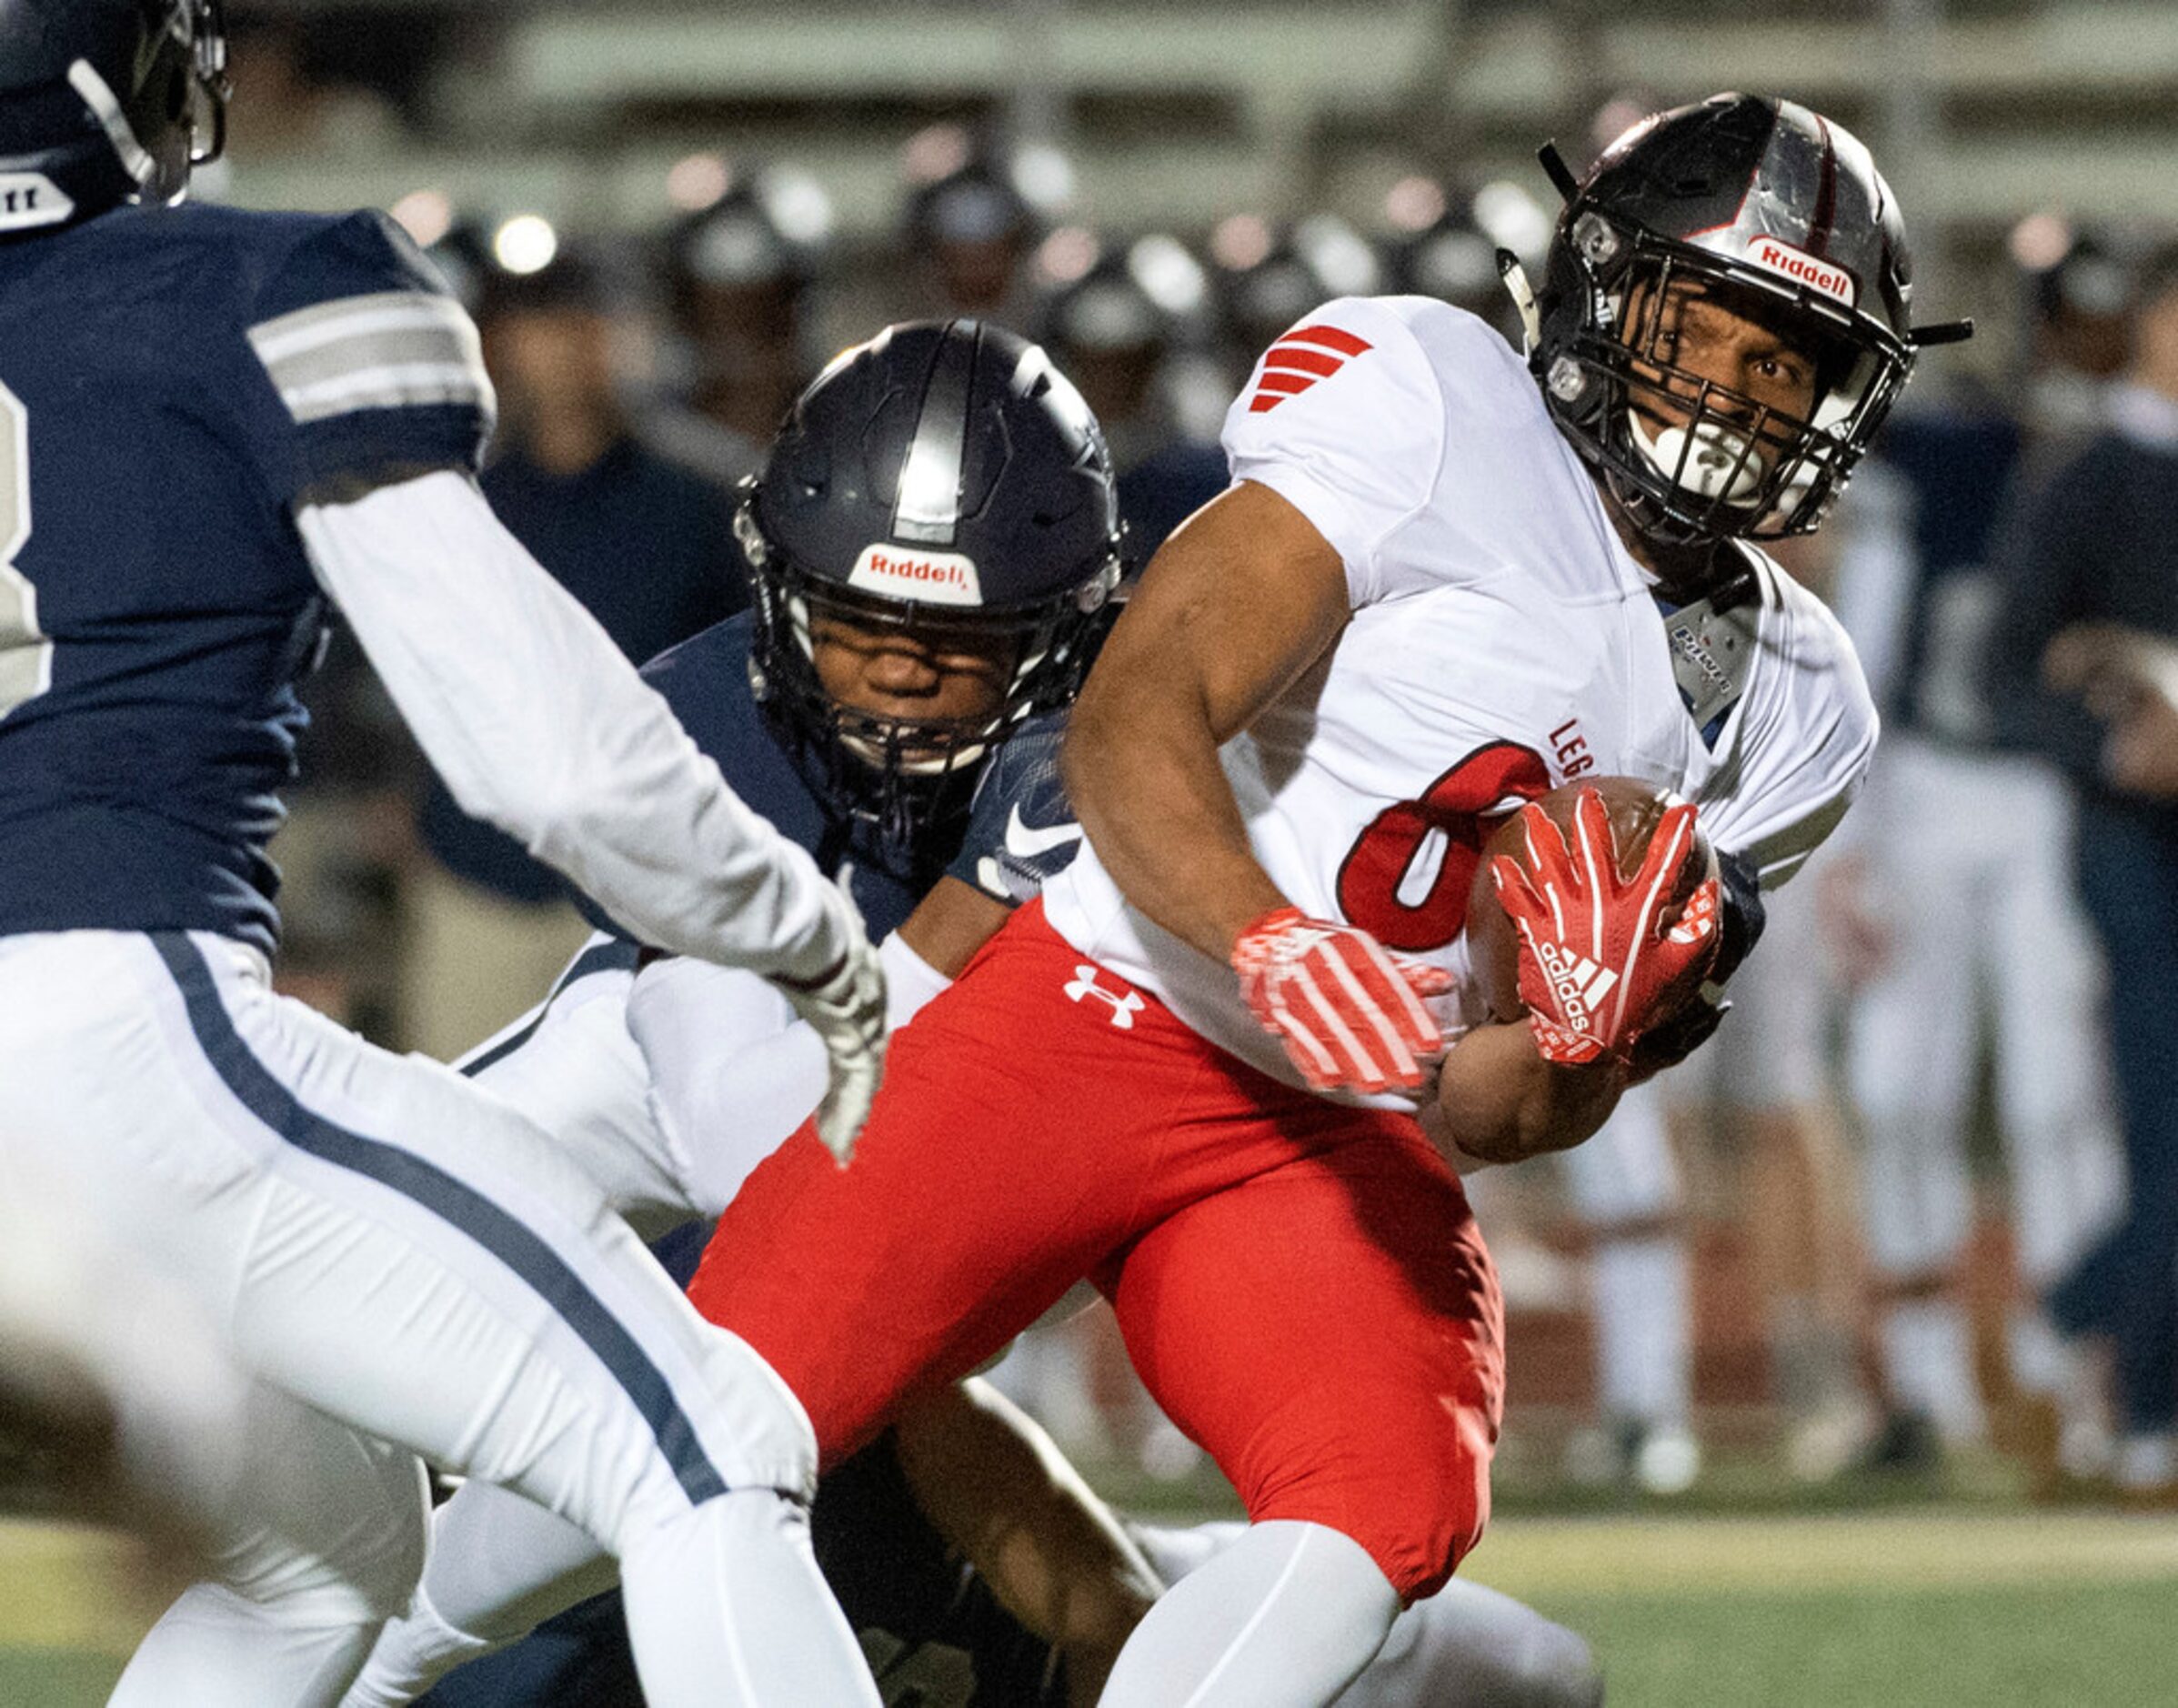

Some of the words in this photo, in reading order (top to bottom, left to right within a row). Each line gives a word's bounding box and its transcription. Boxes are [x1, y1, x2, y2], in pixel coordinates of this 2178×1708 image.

[1761, 245, 1848, 297] Riddell
[869, 553, 965, 585] Riddell
[1548, 718, 1600, 779] LEG
[1541, 941, 1590, 1032] adidas
